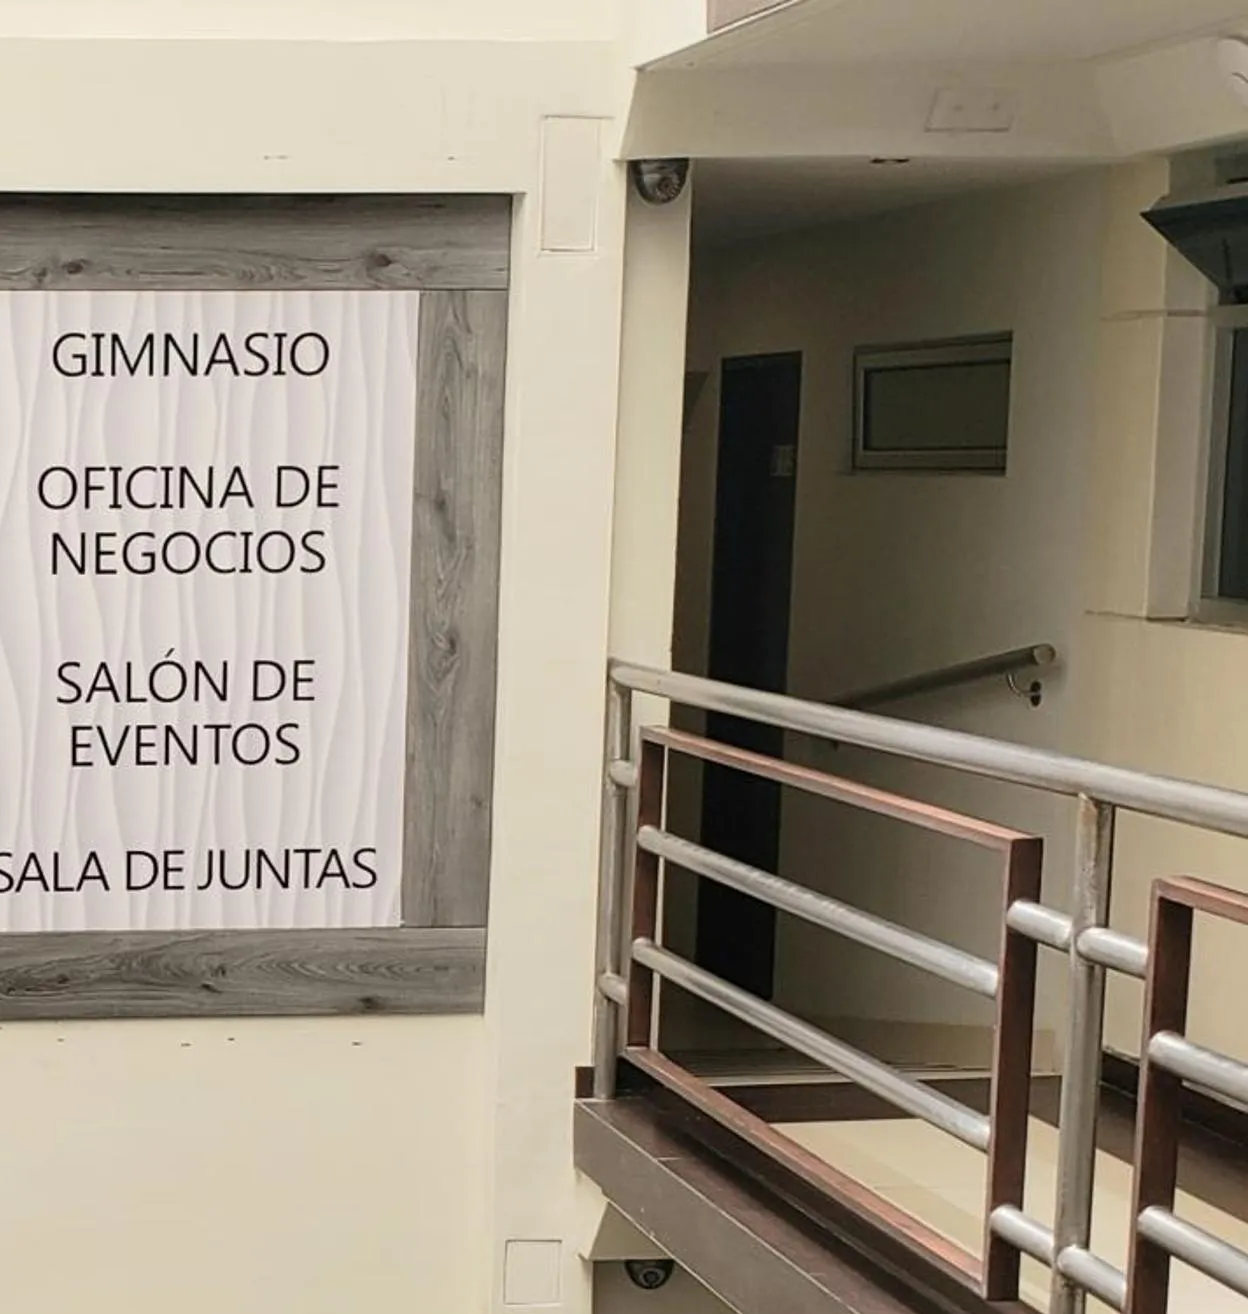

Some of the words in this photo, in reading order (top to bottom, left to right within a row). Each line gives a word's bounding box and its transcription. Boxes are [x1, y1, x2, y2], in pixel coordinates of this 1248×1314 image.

[51, 331, 330, 378] GIMNASIO
[36, 464, 255, 511] OFICINA
[275, 464, 341, 509] DE
[51, 530, 327, 576] NEGOCIOS
[55, 648, 229, 705] SALÓN
[251, 660, 316, 702] DE
[70, 722, 301, 768] EVENTOS
[125, 849, 186, 892] DE
[197, 846, 379, 893] JUNTAS
